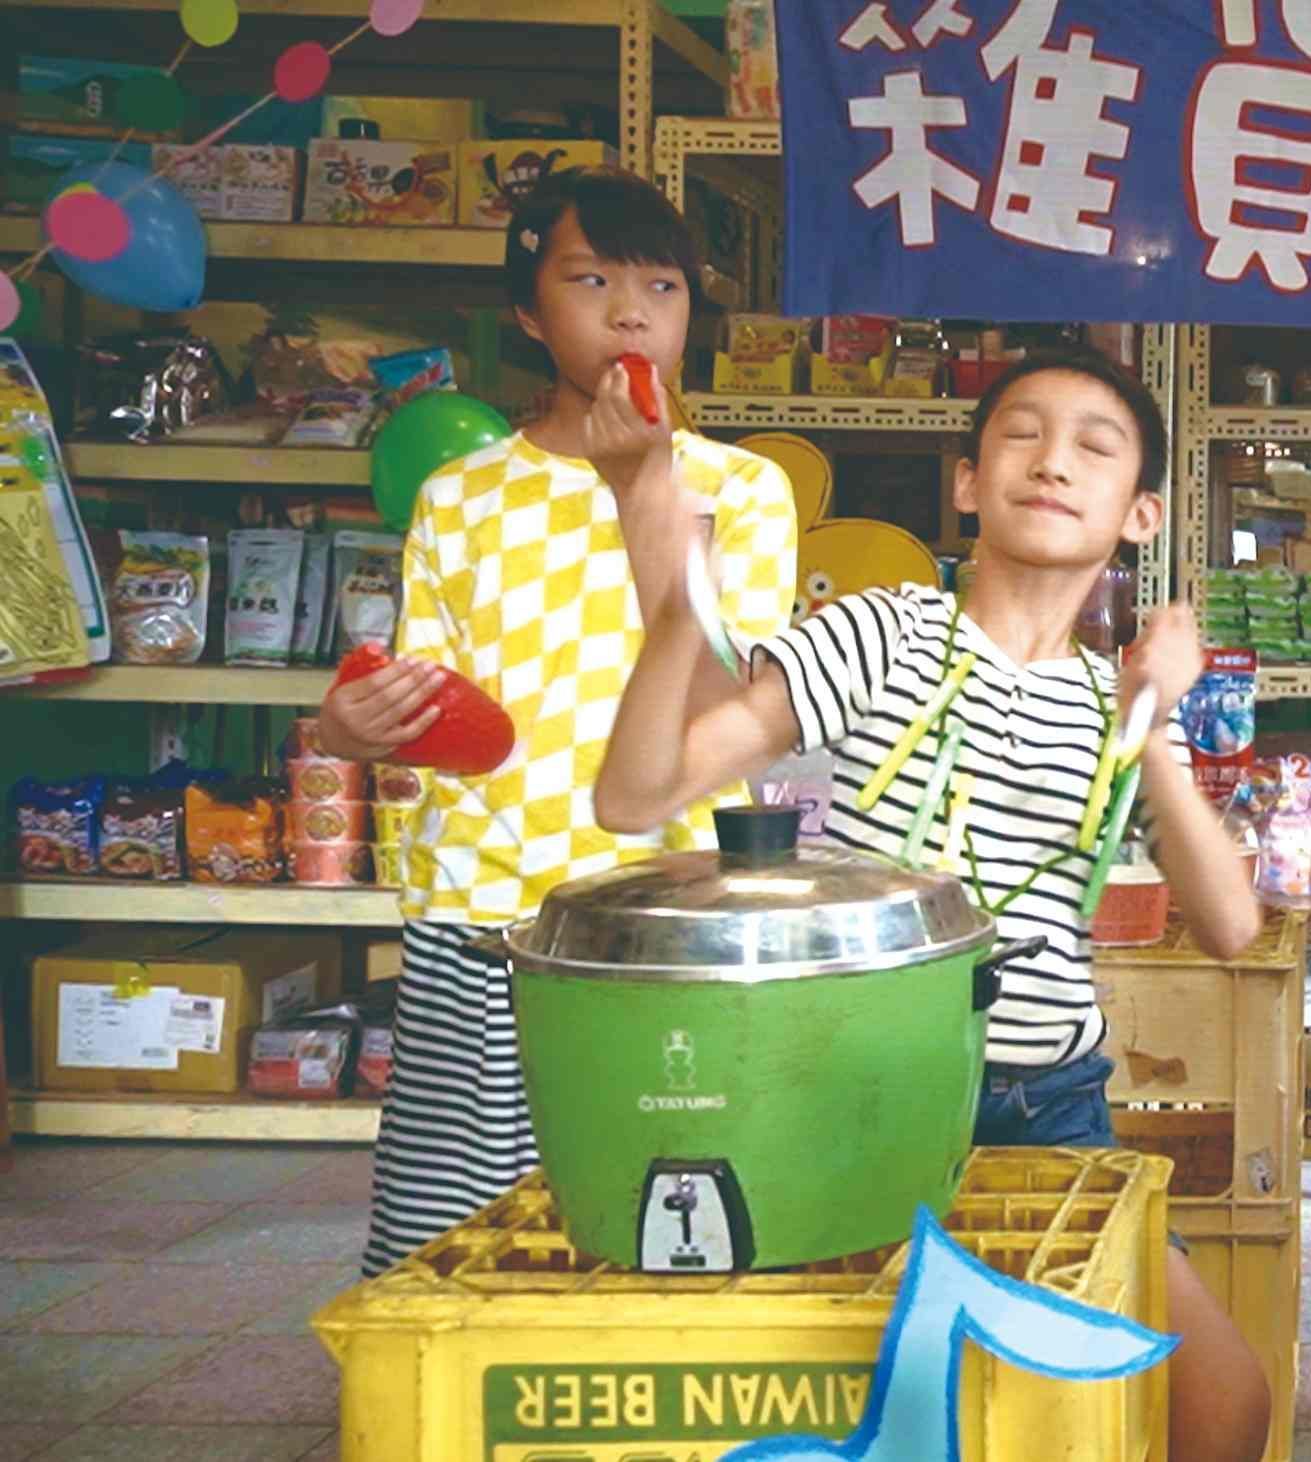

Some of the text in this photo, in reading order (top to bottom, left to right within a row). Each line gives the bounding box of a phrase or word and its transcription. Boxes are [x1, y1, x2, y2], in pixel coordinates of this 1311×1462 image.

[1291, 753, 1310, 778] 2
[654, 1095, 728, 1111] TATUNG
[514, 1373, 872, 1428] AIWAN BEER
